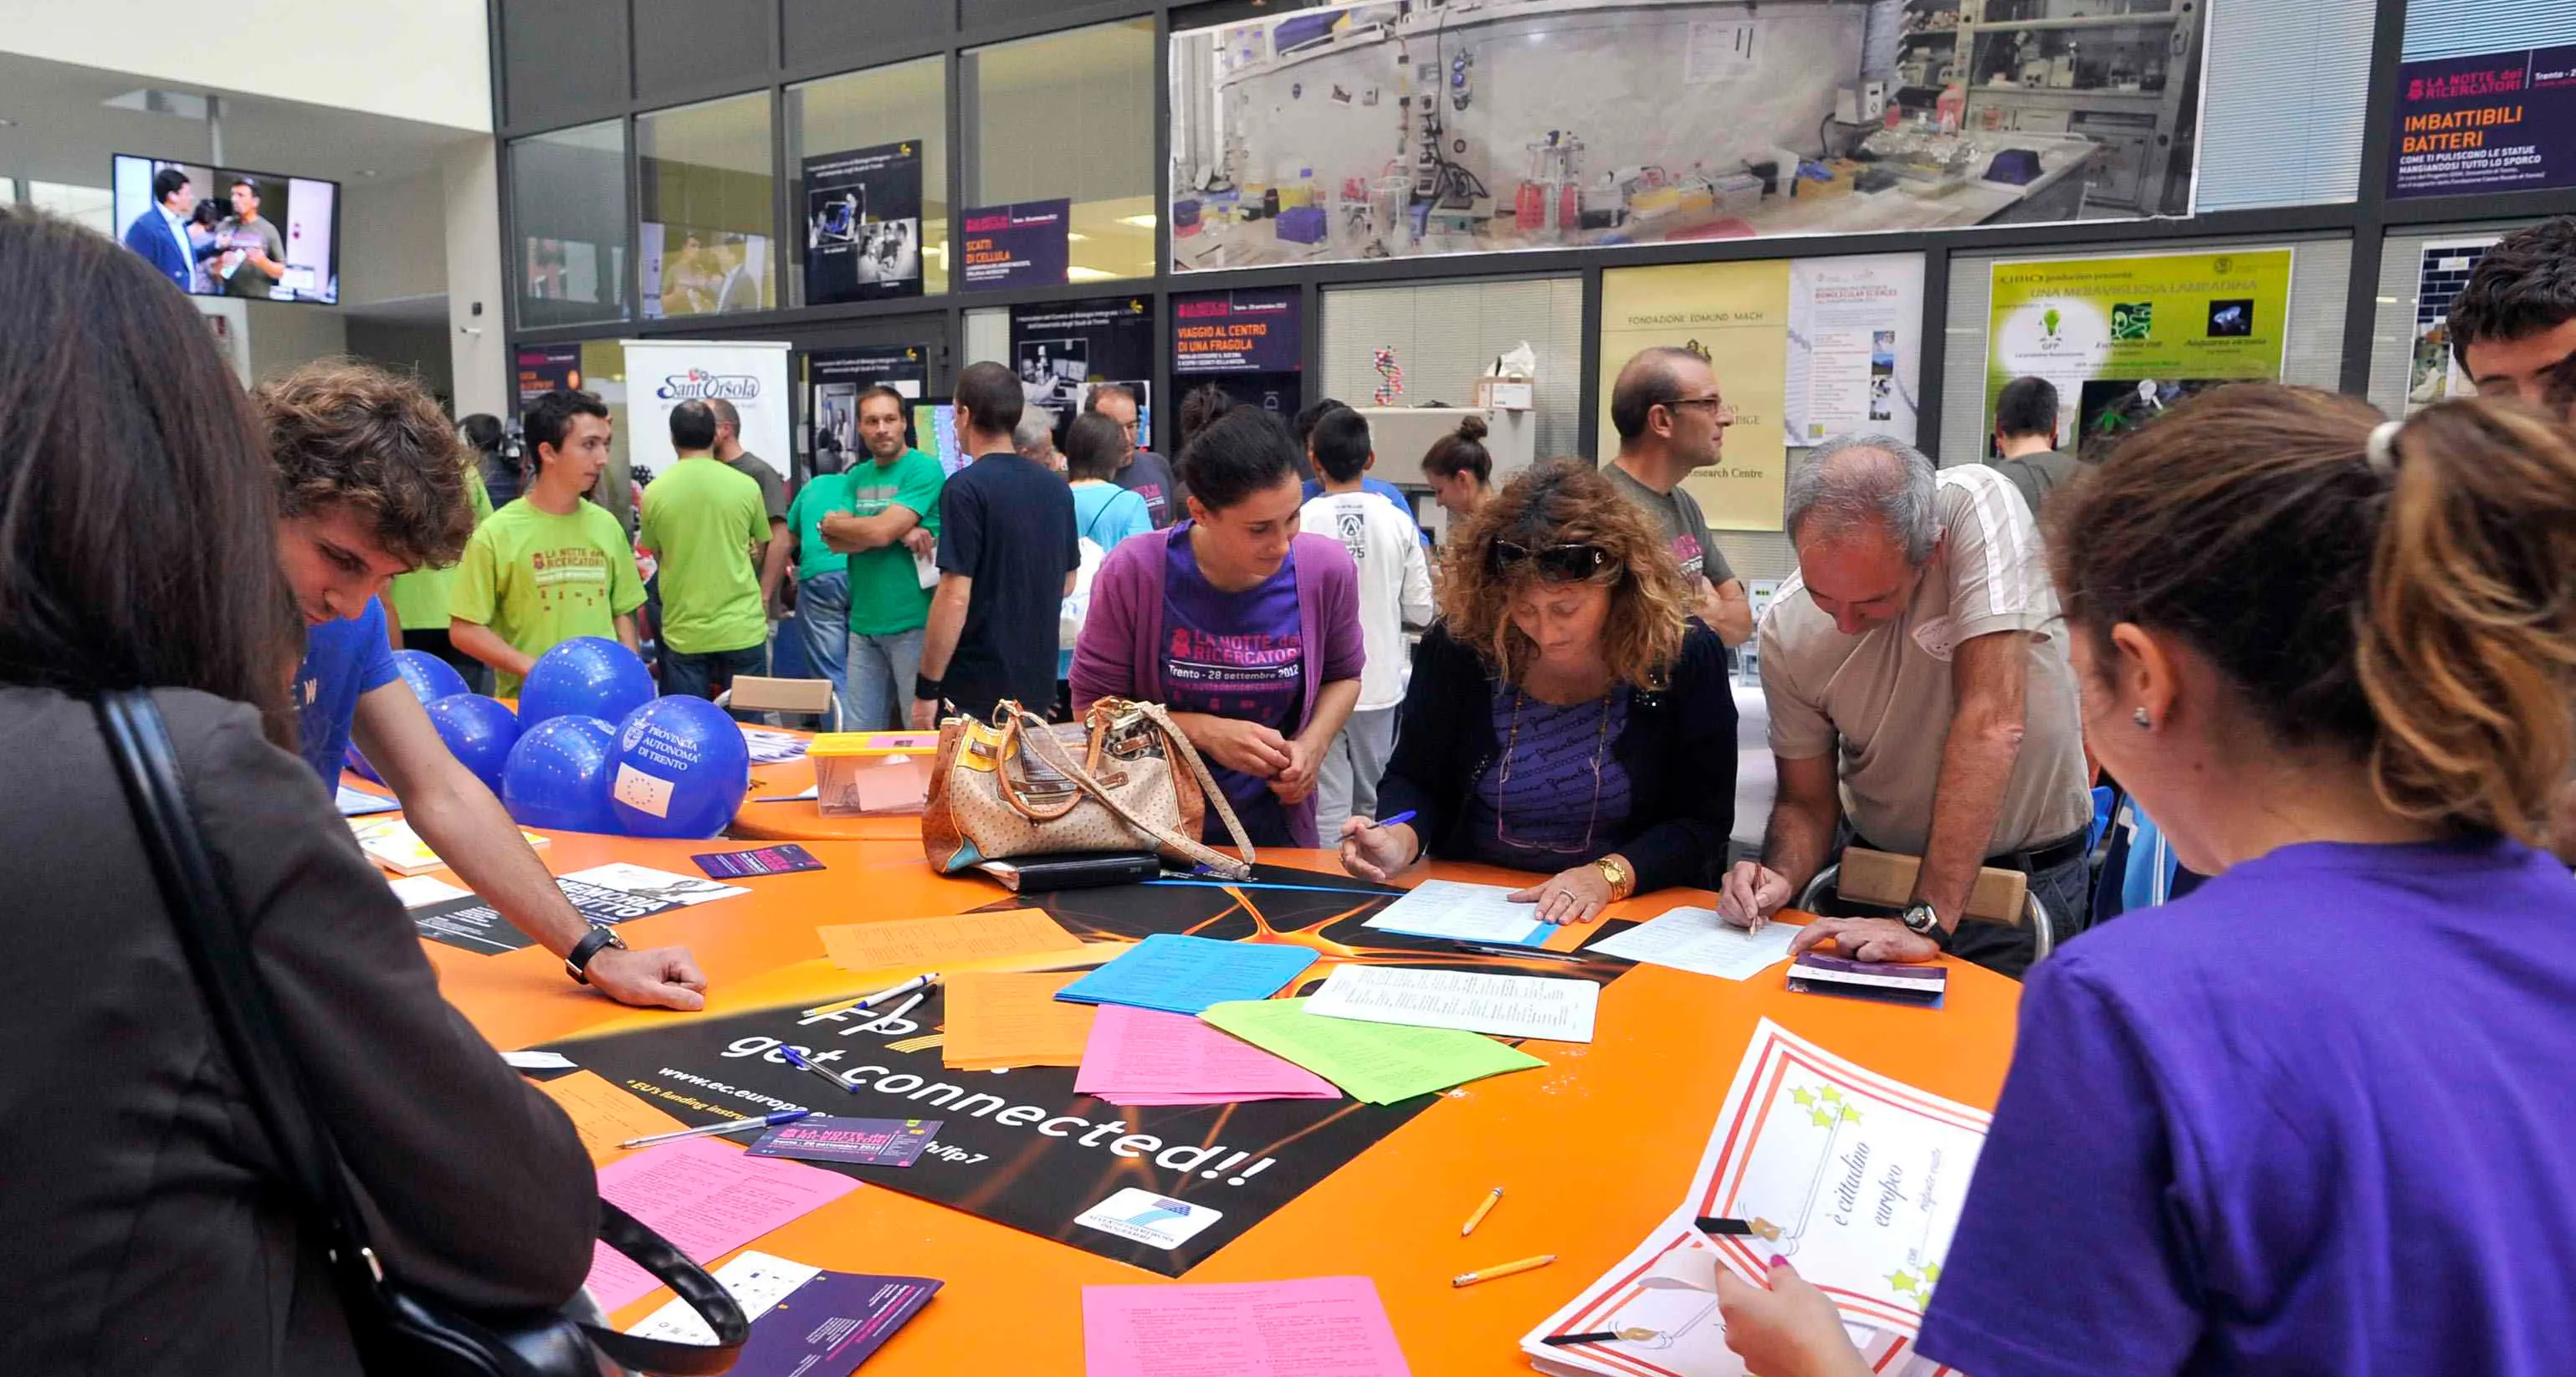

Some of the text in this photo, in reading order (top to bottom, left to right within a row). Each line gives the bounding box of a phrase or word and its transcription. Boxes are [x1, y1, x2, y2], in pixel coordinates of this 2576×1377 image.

[2450, 72, 2497, 85] NOTTE
[2425, 79, 2522, 100] RICERCATORI
[2404, 105, 2524, 132] IMBATTIBILI
[2402, 131, 2485, 153] BATTERI
[2399, 146, 2536, 165] COME TI PULISCONO LE STATUE
[2399, 155, 2542, 174] MANGIANDOSI TUTTO LO SPORCO
[2030, 288, 2061, 299] UNA
[1628, 312, 1763, 325] FONDAZIONE EDMUND MACH
[1177, 324, 1267, 339] VIAGGIO AL CENTRO
[1177, 339, 1253, 352] DI UNA FRAGOLA
[1731, 467, 1764, 479] Centre
[1194, 629, 1216, 647] LA
[1219, 633, 1272, 651] NOTTE
[1168, 665, 1200, 679] Trento
[1208, 670, 1221, 680] 28
[1224, 671, 1277, 680] settembre
[1278, 664, 1299, 678] 2012
[648, 725, 698, 752] PROVINCIA
[638, 746, 688, 771] DI TRENTO
[642, 737, 699, 764] AUTONOMA
[659, 1090, 709, 1111] funding
[720, 1036, 1277, 1186] get connected!!
[822, 1129, 866, 1139] NOTTE
[1833, 1140, 1871, 1214] cittadino
[1874, 1164, 1908, 1227] europeo
